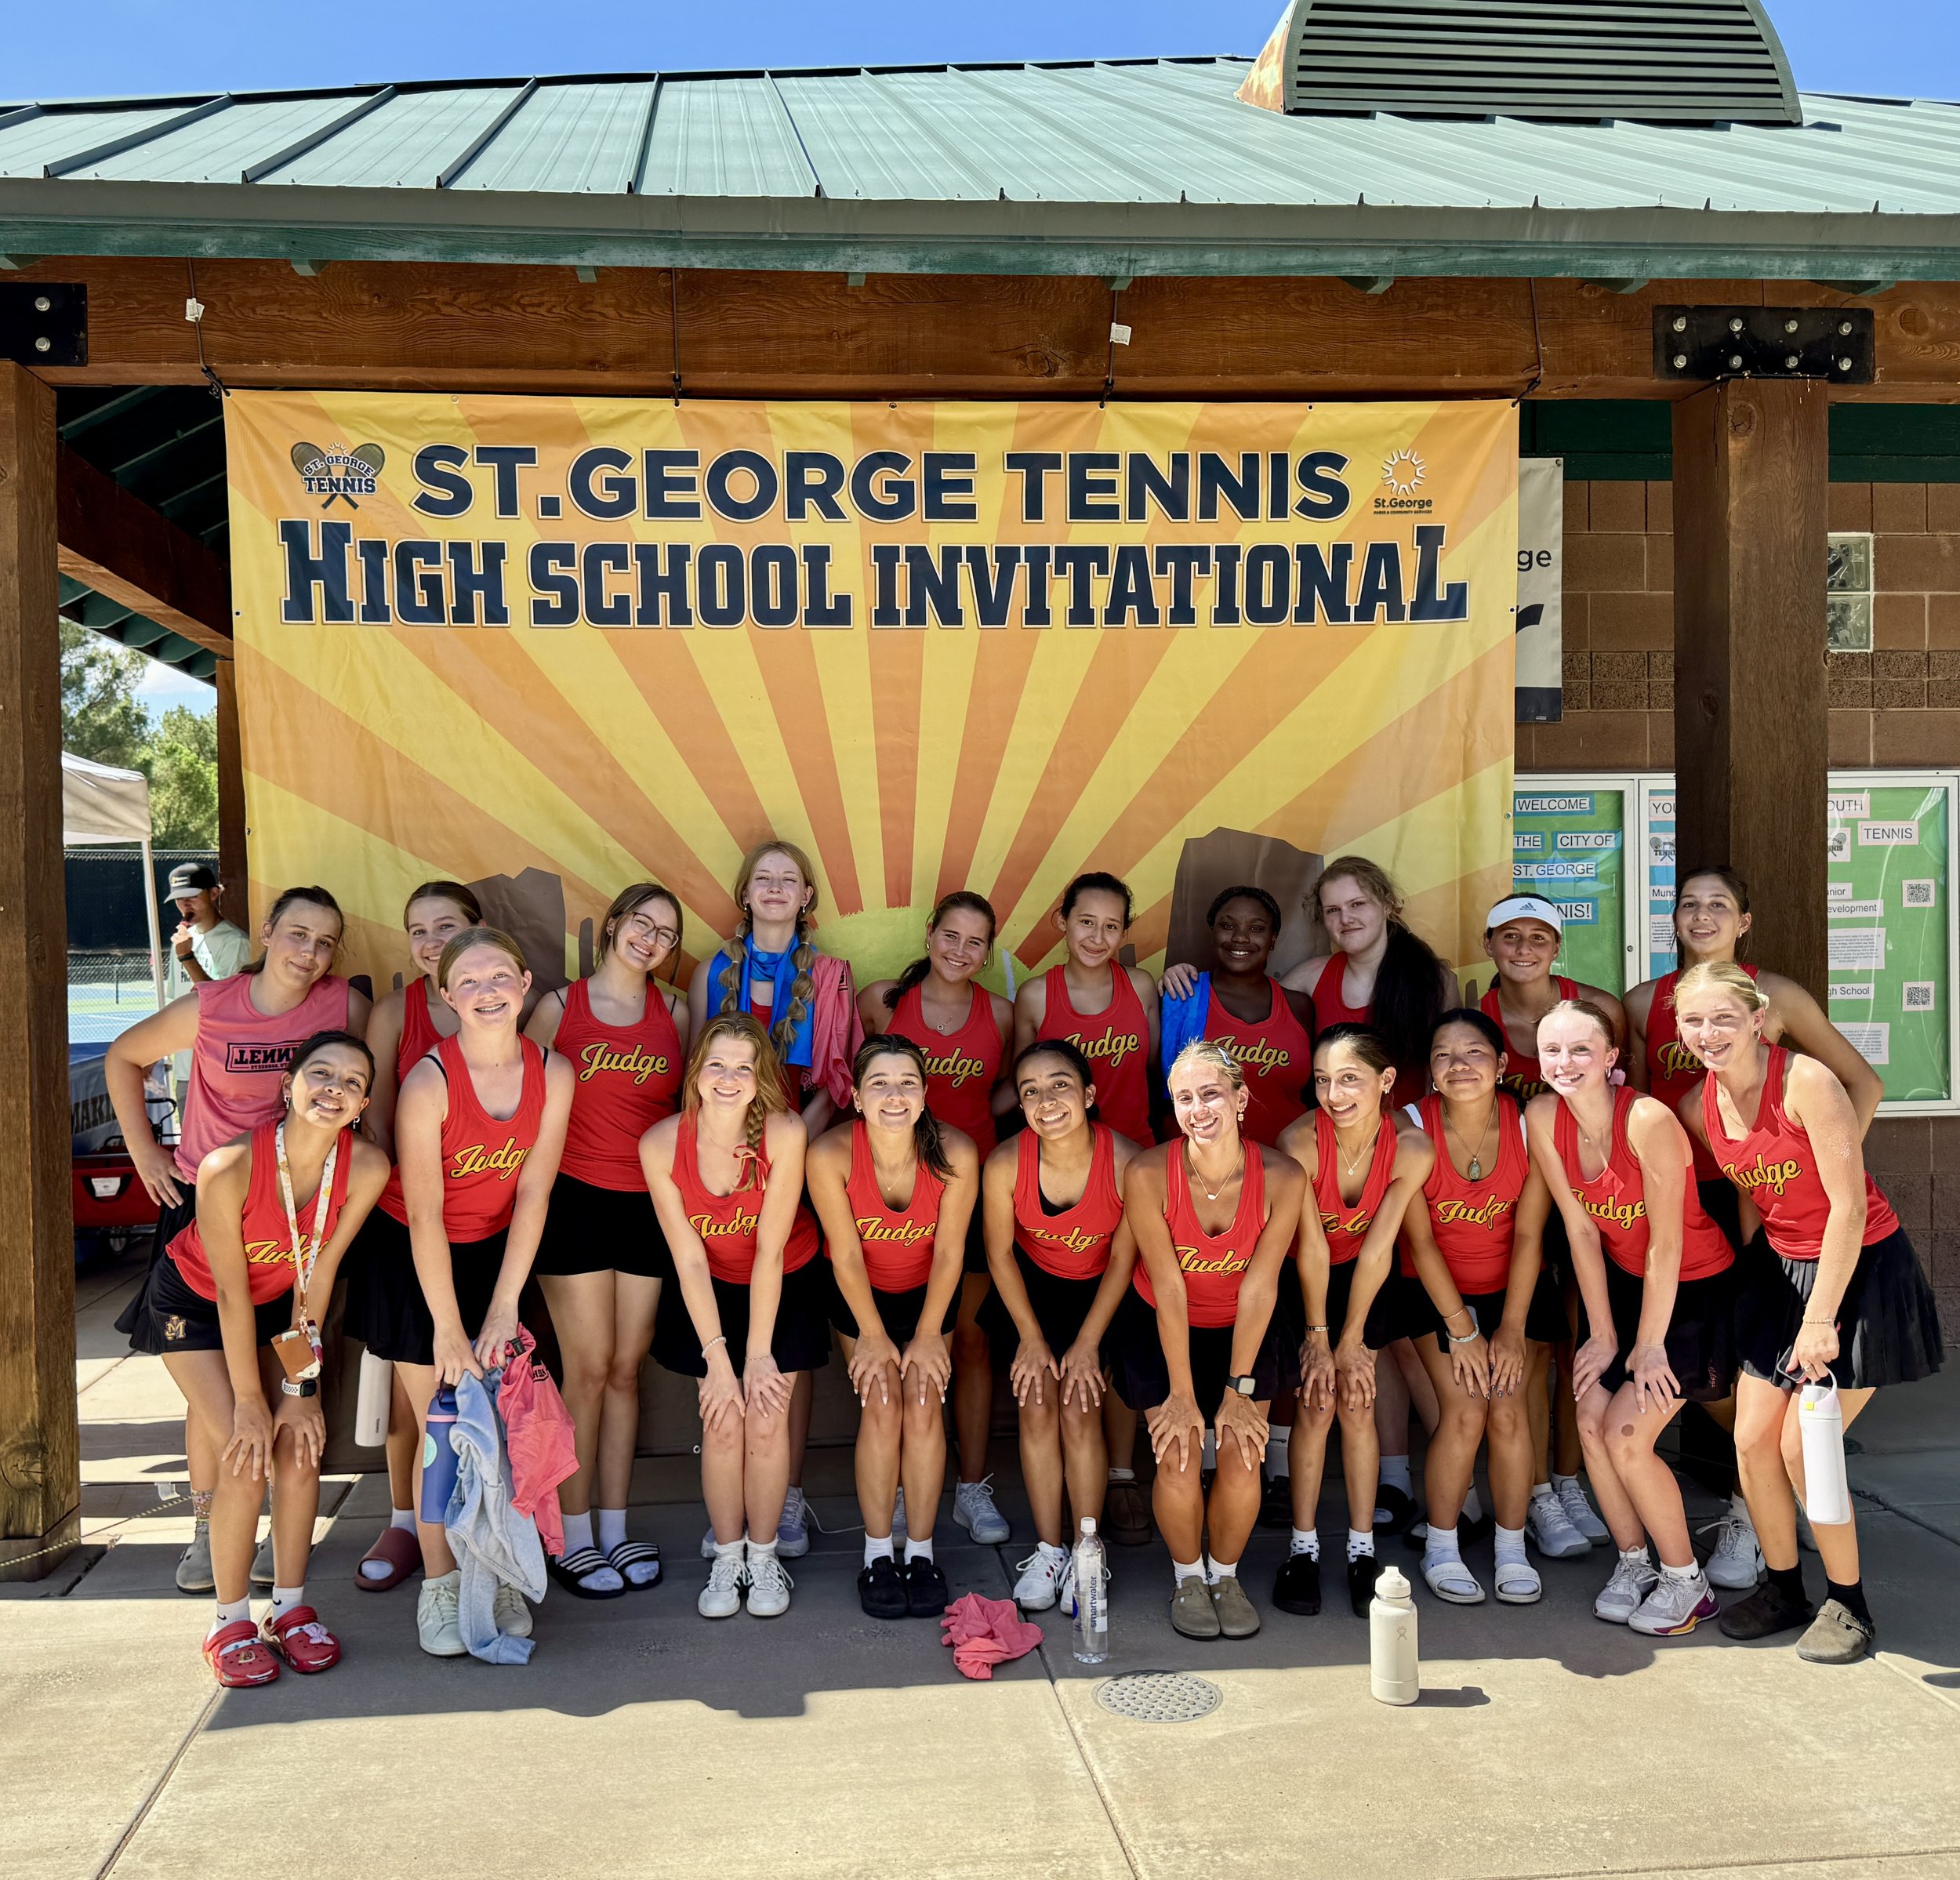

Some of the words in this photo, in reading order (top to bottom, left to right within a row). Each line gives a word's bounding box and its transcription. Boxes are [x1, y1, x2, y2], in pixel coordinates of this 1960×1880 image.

[304, 459, 325, 474] ST.
[325, 455, 376, 476] GEORGE
[303, 476, 376, 494] TENNIS
[1004, 450, 1352, 524] TENNIS
[278, 518, 510, 626] HIGH
[527, 540, 853, 630] SCHOOL
[870, 524, 1468, 629] INVITATIONAL
[1518, 799, 1588, 811] WELCOME
[1514, 836, 1541, 847] THE
[1560, 836, 1590, 847] CITY
[1594, 835, 1613, 846] OF
[1864, 827, 1913, 839] TENNIS
[1513, 865, 1533, 876] ST.
[1536, 864, 1595, 876] GEORGE
[1839, 986, 1870, 995] School
[579, 1042, 670, 1086] Judge
[919, 1047, 984, 1088] udge
[689, 1207, 760, 1238] Judg
[855, 1217, 937, 1247] Judge
[245, 1234, 328, 1270] Judg
